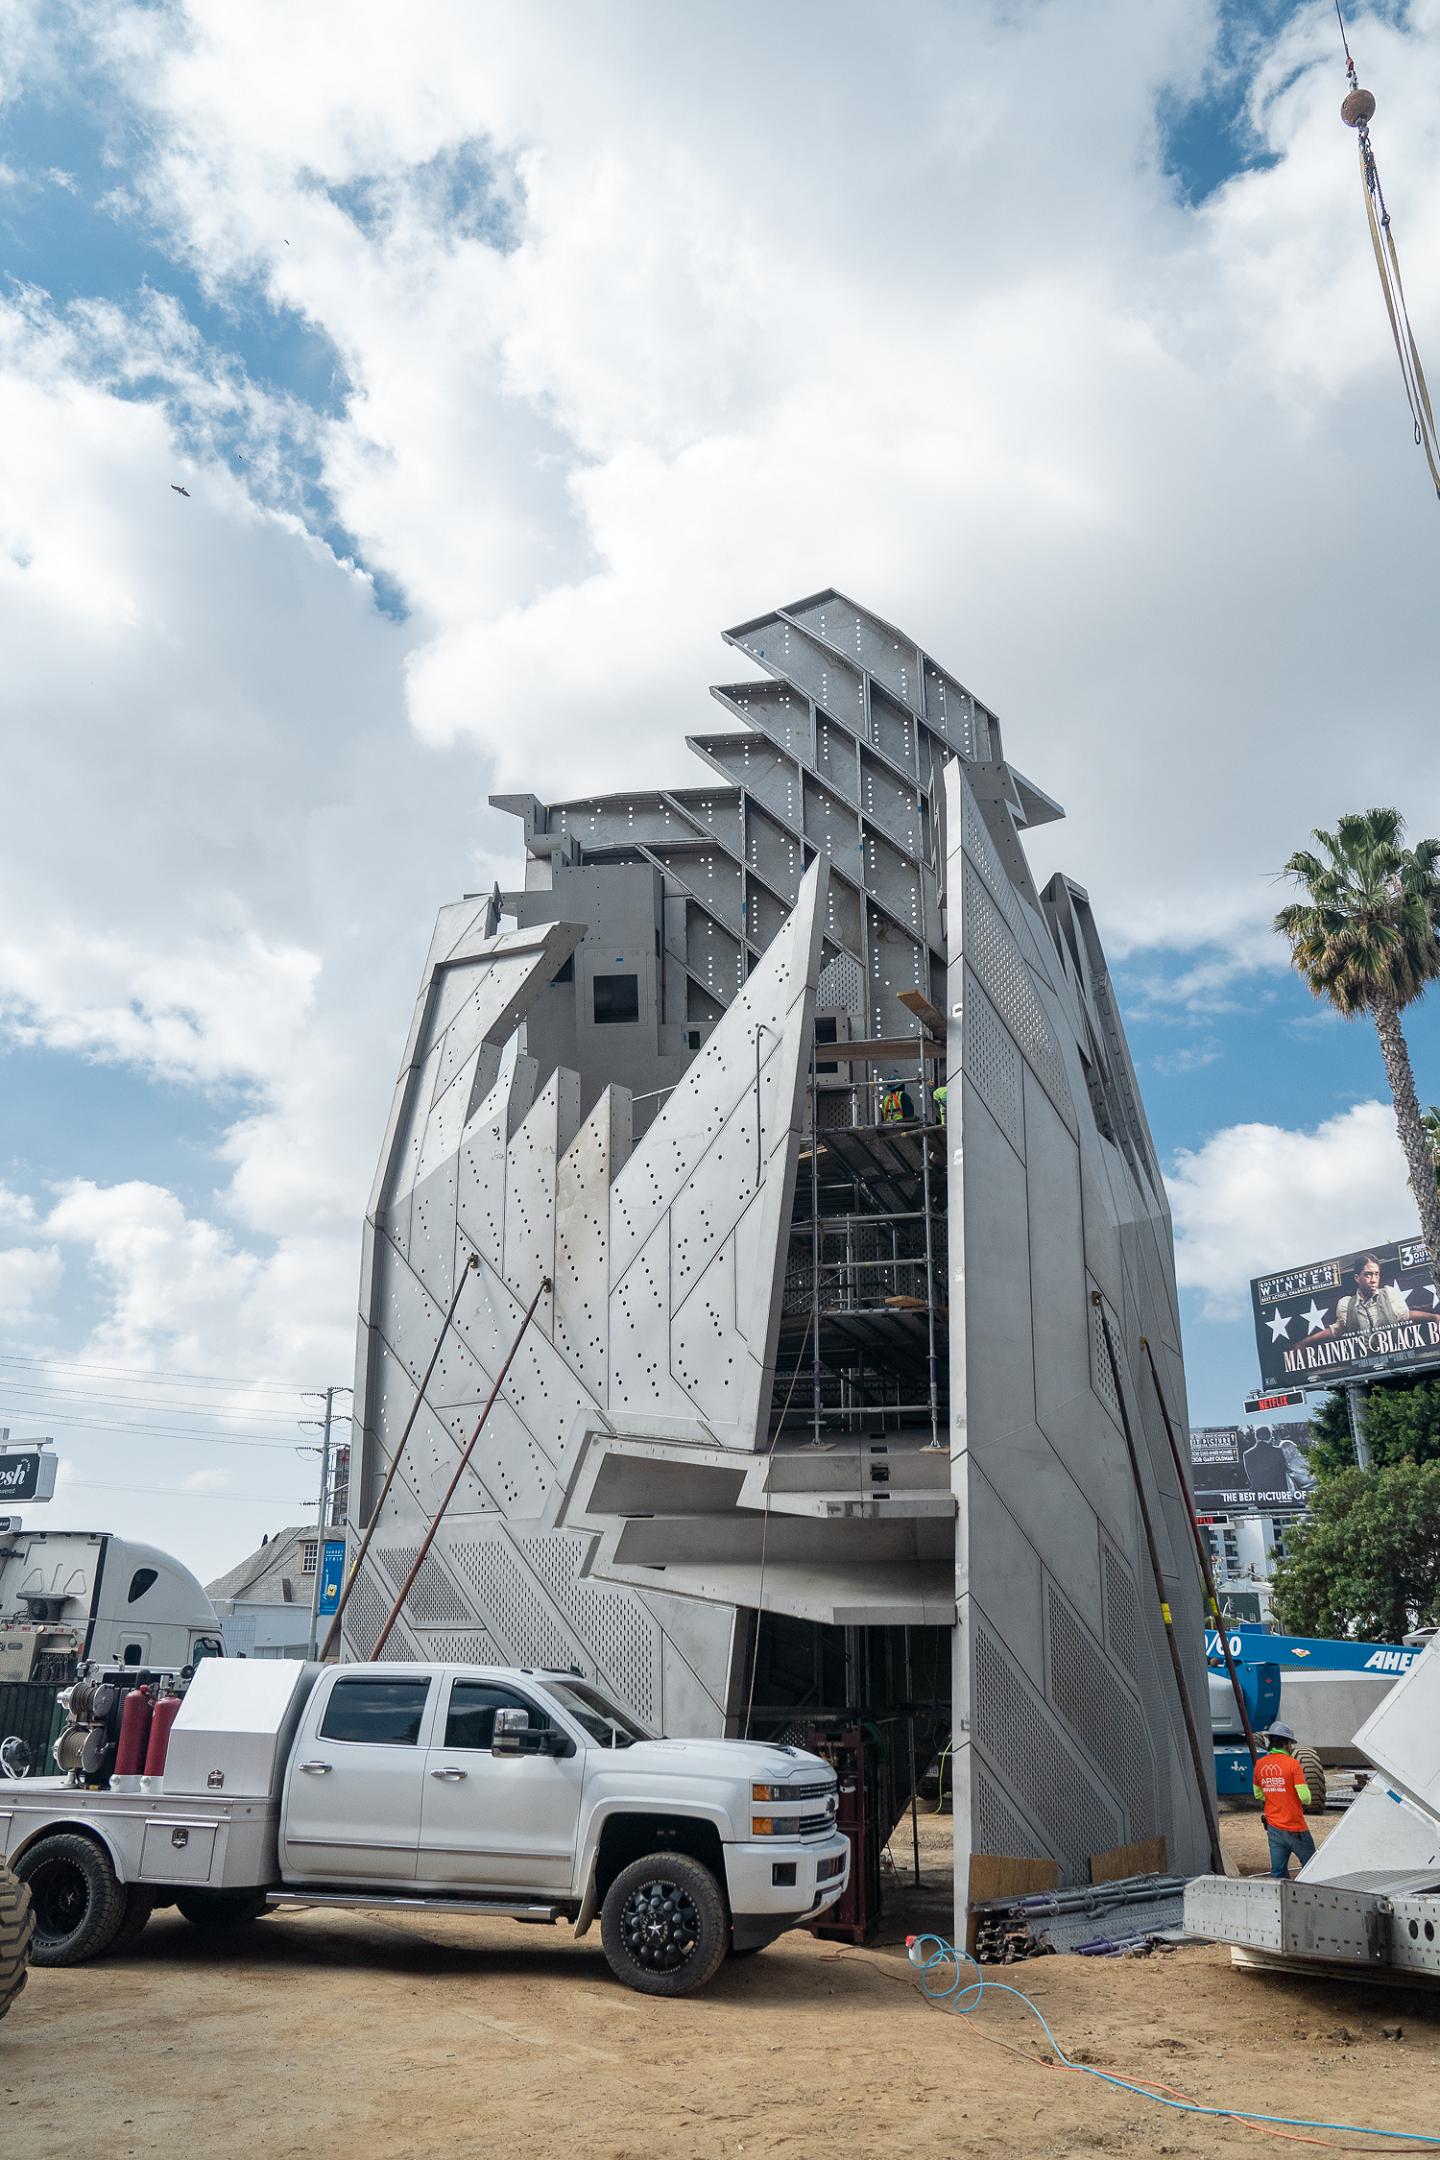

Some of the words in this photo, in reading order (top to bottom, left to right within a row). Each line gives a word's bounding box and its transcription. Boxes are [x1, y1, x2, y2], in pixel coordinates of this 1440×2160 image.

[1401, 1246, 1414, 1266] 3
[1260, 1278, 1284, 1288] GOLDEN
[1310, 1265, 1331, 1276] AWARD
[1261, 1271, 1332, 1296] WINNER
[1372, 1320, 1413, 1332] CONSIDERATION
[1283, 1349, 1306, 1373] MA
[1306, 1335, 1368, 1369] RAINEY'S
[1369, 1323, 1426, 1354] BLACK
[1259, 1395, 1288, 1410] NETFLIX
[1222, 1493, 1237, 1502] THE
[1239, 1492, 1256, 1502] BEST
[1258, 1490, 1292, 1501] PICTURE
[1293, 1490, 1307, 1500] OF
